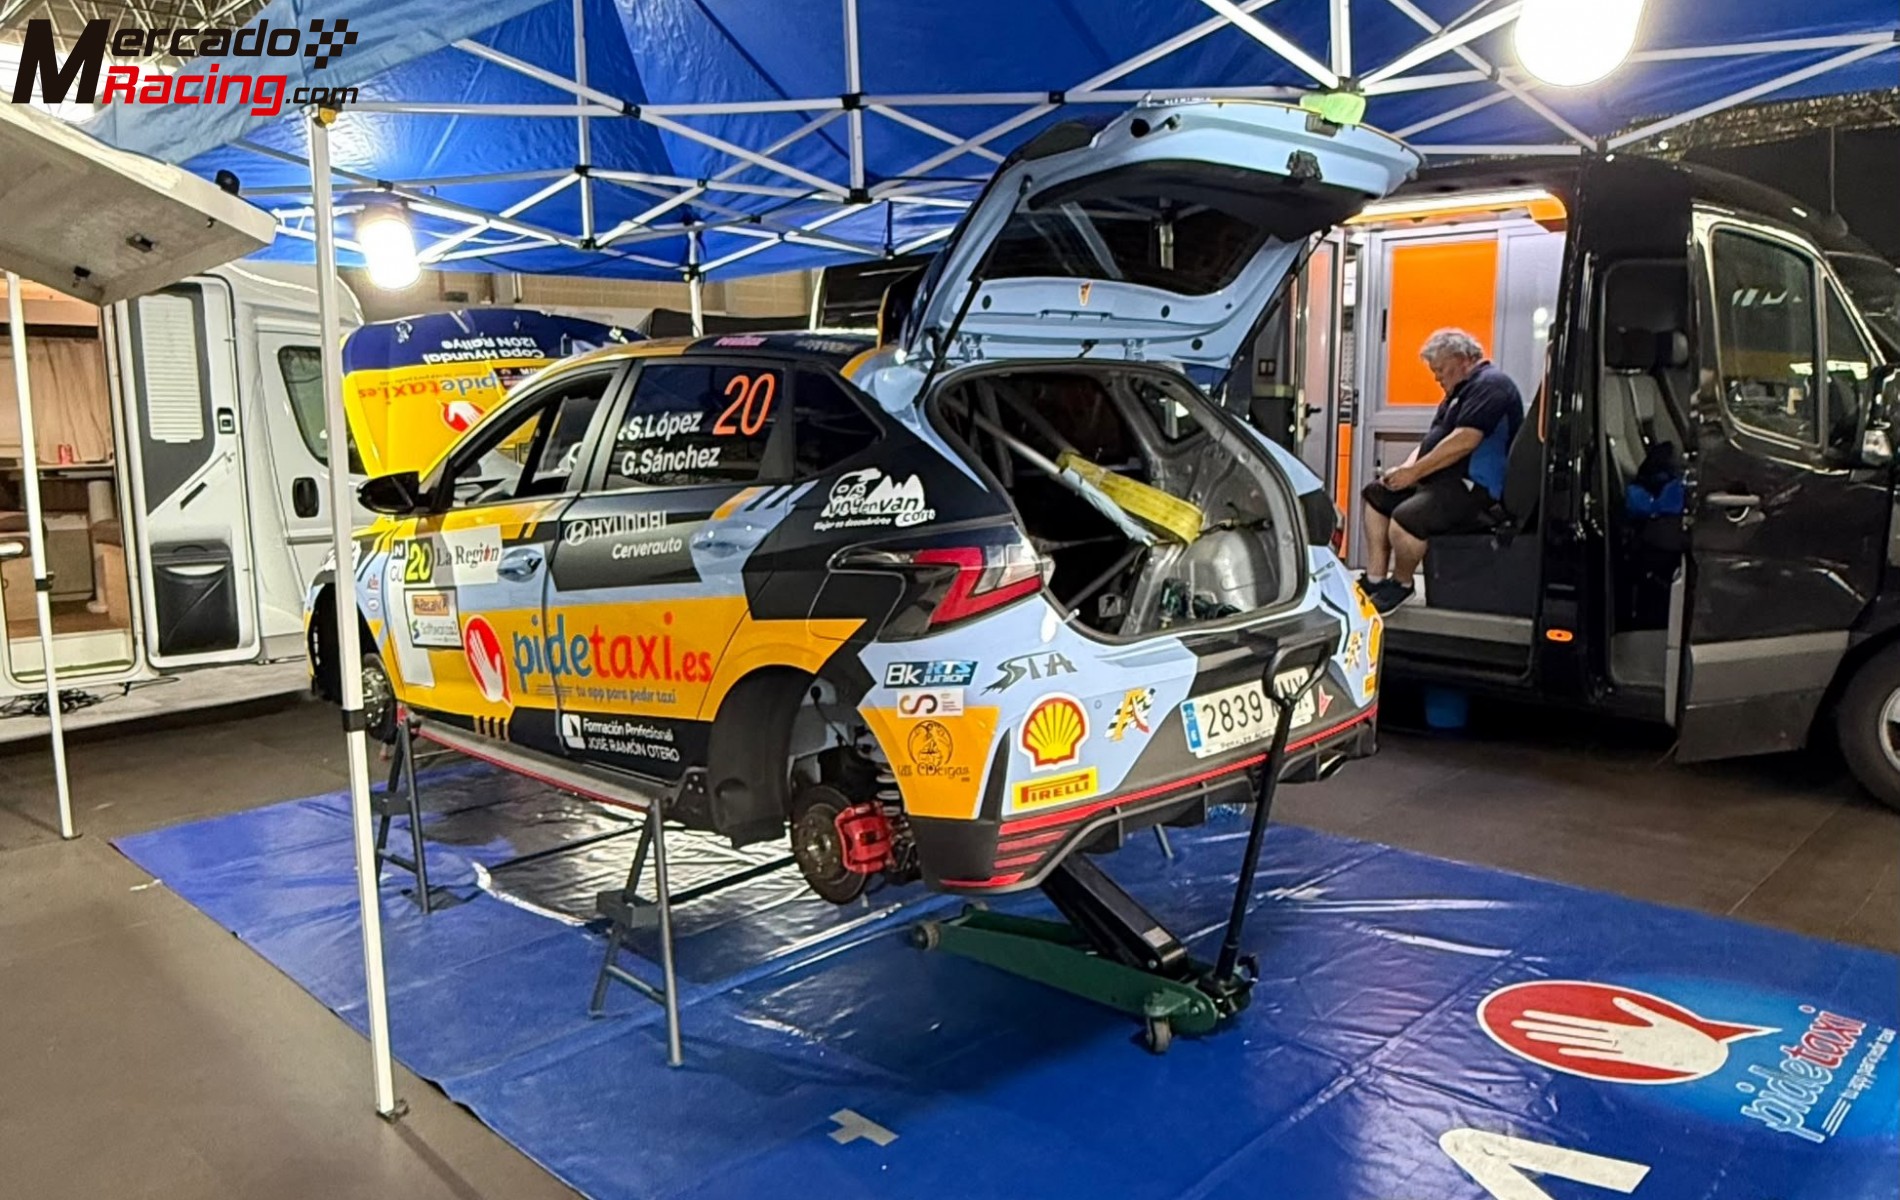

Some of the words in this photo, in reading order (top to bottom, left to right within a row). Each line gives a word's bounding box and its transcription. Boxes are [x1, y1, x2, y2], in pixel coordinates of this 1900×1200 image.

[422, 349, 497, 365] Hyundai
[441, 337, 496, 350] Rallye
[499, 348, 545, 359] Copa
[712, 373, 775, 436] 20
[627, 411, 703, 441] S.López
[621, 444, 721, 476] G.Sánchez
[591, 511, 667, 539] HYUNDAI
[405, 543, 433, 581] 20
[436, 549, 452, 566] La
[612, 538, 683, 560] Cerverauto
[512, 611, 713, 693] pidetaxi.es
[926, 660, 974, 675] RTS
[657, 689, 676, 704] taxi
[583, 718, 624, 736] Formación
[1202, 690, 1263, 739] 2839
[1021, 774, 1089, 804] PIRELLI
[1736, 1004, 1867, 1143] pidetaxi
